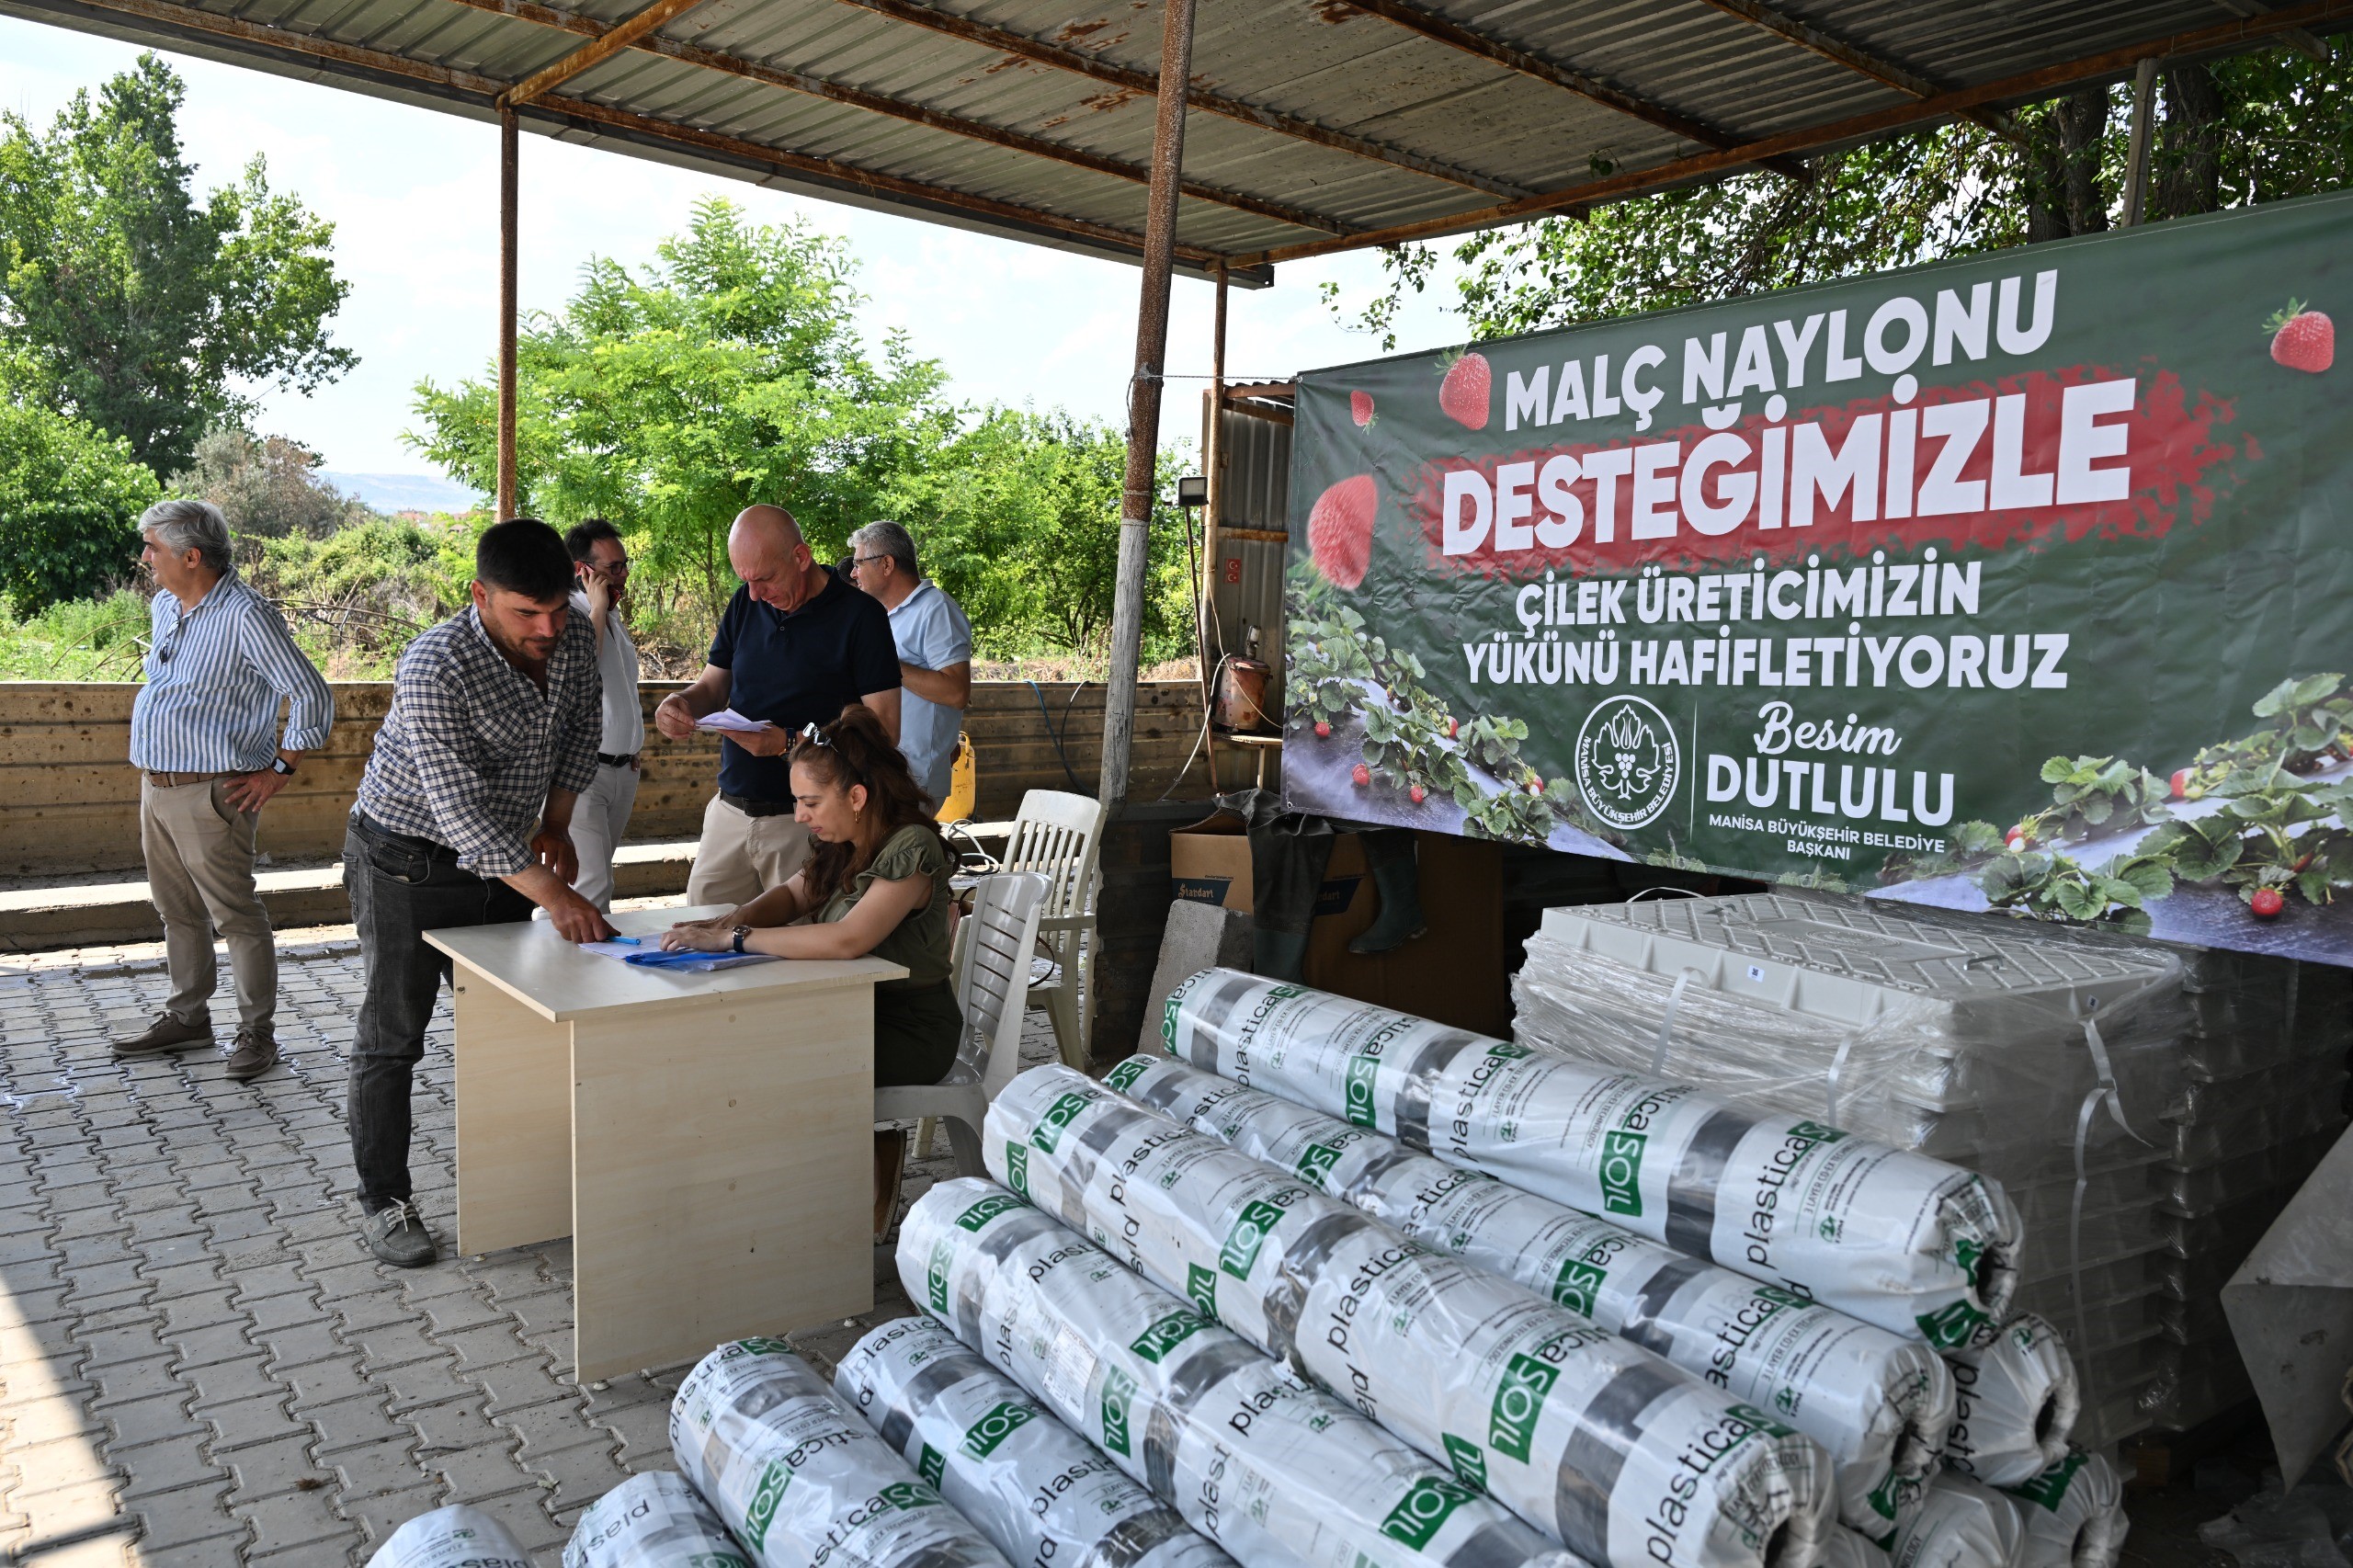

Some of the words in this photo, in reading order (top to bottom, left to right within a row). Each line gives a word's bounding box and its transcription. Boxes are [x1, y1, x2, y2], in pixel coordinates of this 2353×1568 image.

[1506, 345, 1665, 432] MALÇ
[1682, 269, 2058, 404] NAYLONU
[1442, 374, 2136, 556] DESTEĞİMİZLE
[1516, 571, 1626, 638] ÇİLEK
[1636, 548, 1982, 625] ÜRETİCİMİZİN
[1463, 630, 1620, 685] YÜKÜNÜ
[1631, 621, 2070, 689] HAFİFLETİYORUZ
[1753, 700, 1902, 756] Besim
[1580, 735, 1592, 789] MANİSA
[1586, 787, 1648, 824] BÜYÜKŞEHİR
[1646, 742, 1673, 814] BELEDİYESİ
[1706, 754, 1955, 826] DUTLULU
[1709, 813, 1764, 832] MANİSA
[1768, 818, 1860, 844] BÜYÜKŞEHİR
[1863, 832, 1945, 853] BELEDİYE
[1787, 839, 1850, 860] BAŞKANI
[1029, 1096, 1085, 1145] SOIL
[1449, 1056, 1503, 1164] plastica
[1605, 1134, 1640, 1210] SOIL
[1744, 1136, 1813, 1271] plastica
[1220, 1205, 1277, 1269] SOIL
[931, 1244, 951, 1306] SOIL
[959, 1405, 1029, 1451] SOIL
[1105, 1370, 1134, 1445] SOIL
[1490, 1360, 1549, 1448] SOIL
[1381, 1482, 1466, 1537] SOIL
[1645, 1417, 1751, 1568] plastica
